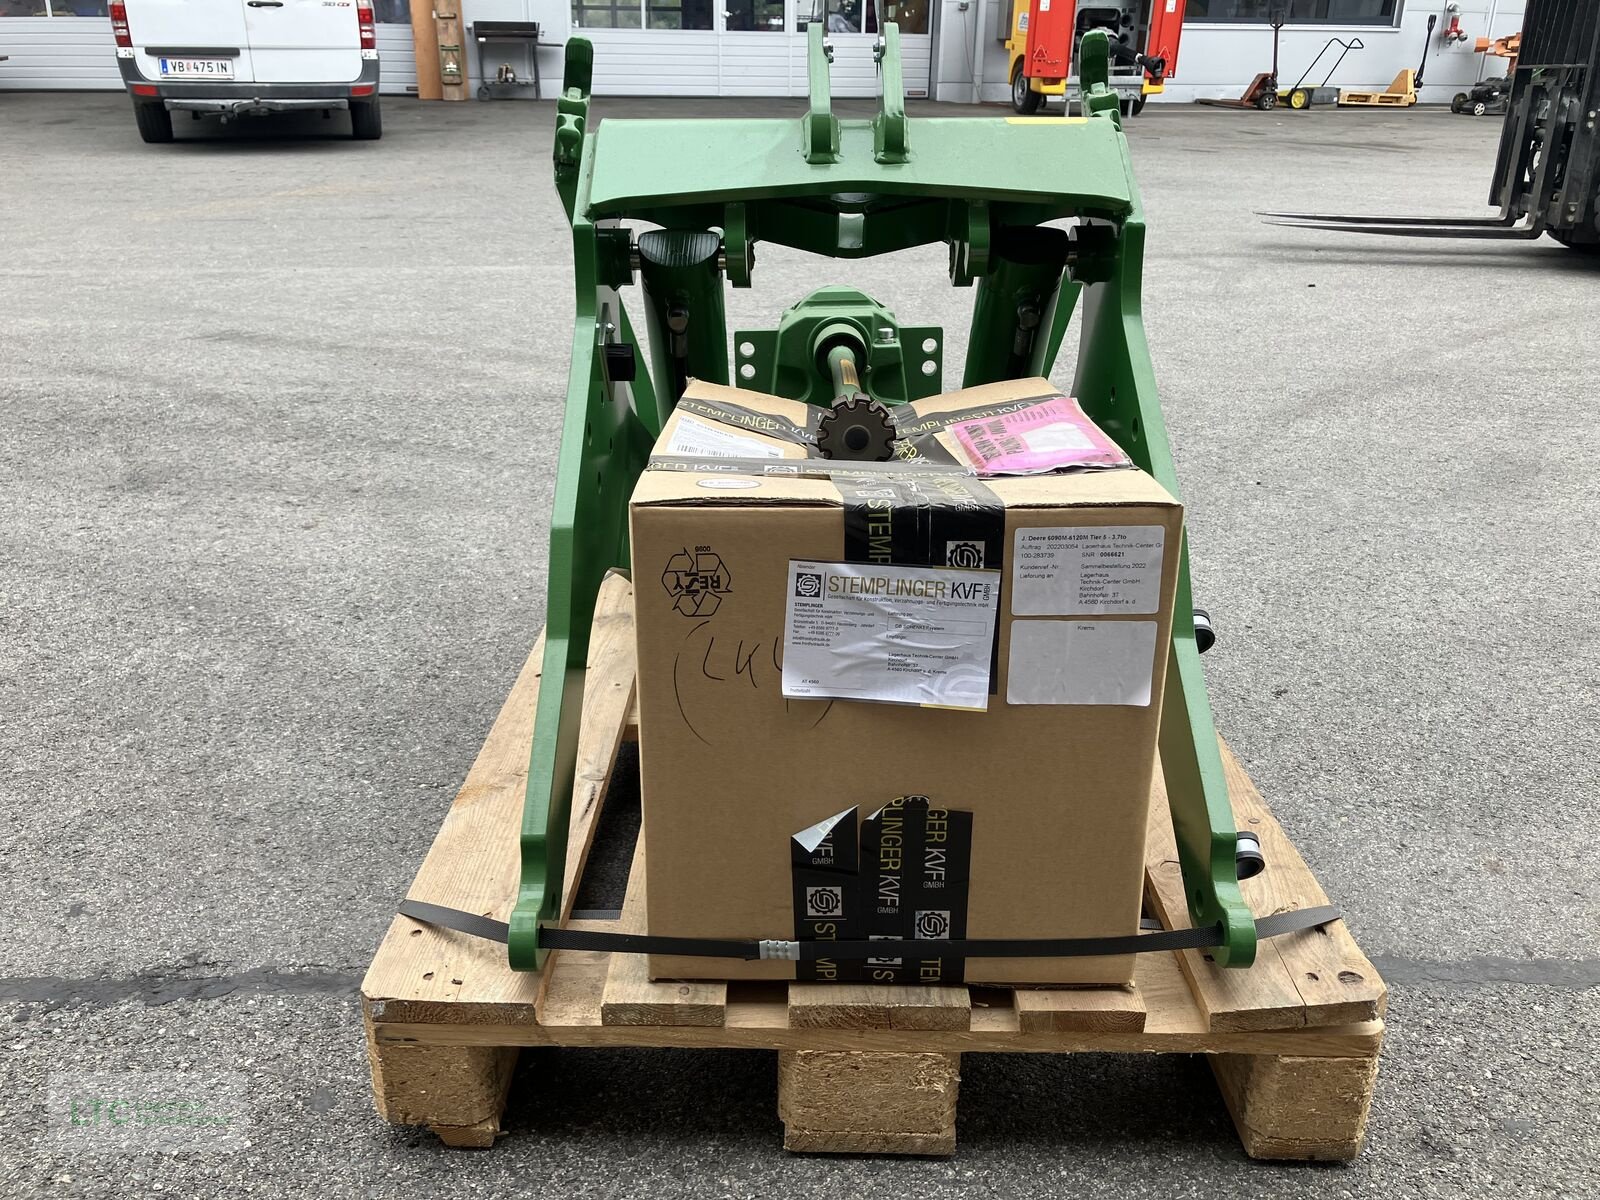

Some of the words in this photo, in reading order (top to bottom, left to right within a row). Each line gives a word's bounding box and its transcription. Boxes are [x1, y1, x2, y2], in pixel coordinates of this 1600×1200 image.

[171, 61, 185, 72] VB
[193, 62, 214, 73] 475
[216, 62, 228, 73] IN
[674, 573, 721, 593] RESY
[828, 575, 946, 599] STEMPLINGER
[951, 582, 984, 600] KVF
[983, 583, 991, 601] GMBH
[827, 593, 856, 601] Gesellschaft
[811, 857, 834, 865] GMBH
[924, 847, 946, 881] KVF
[878, 874, 901, 907] KVF
[922, 881, 945, 889] GMBH
